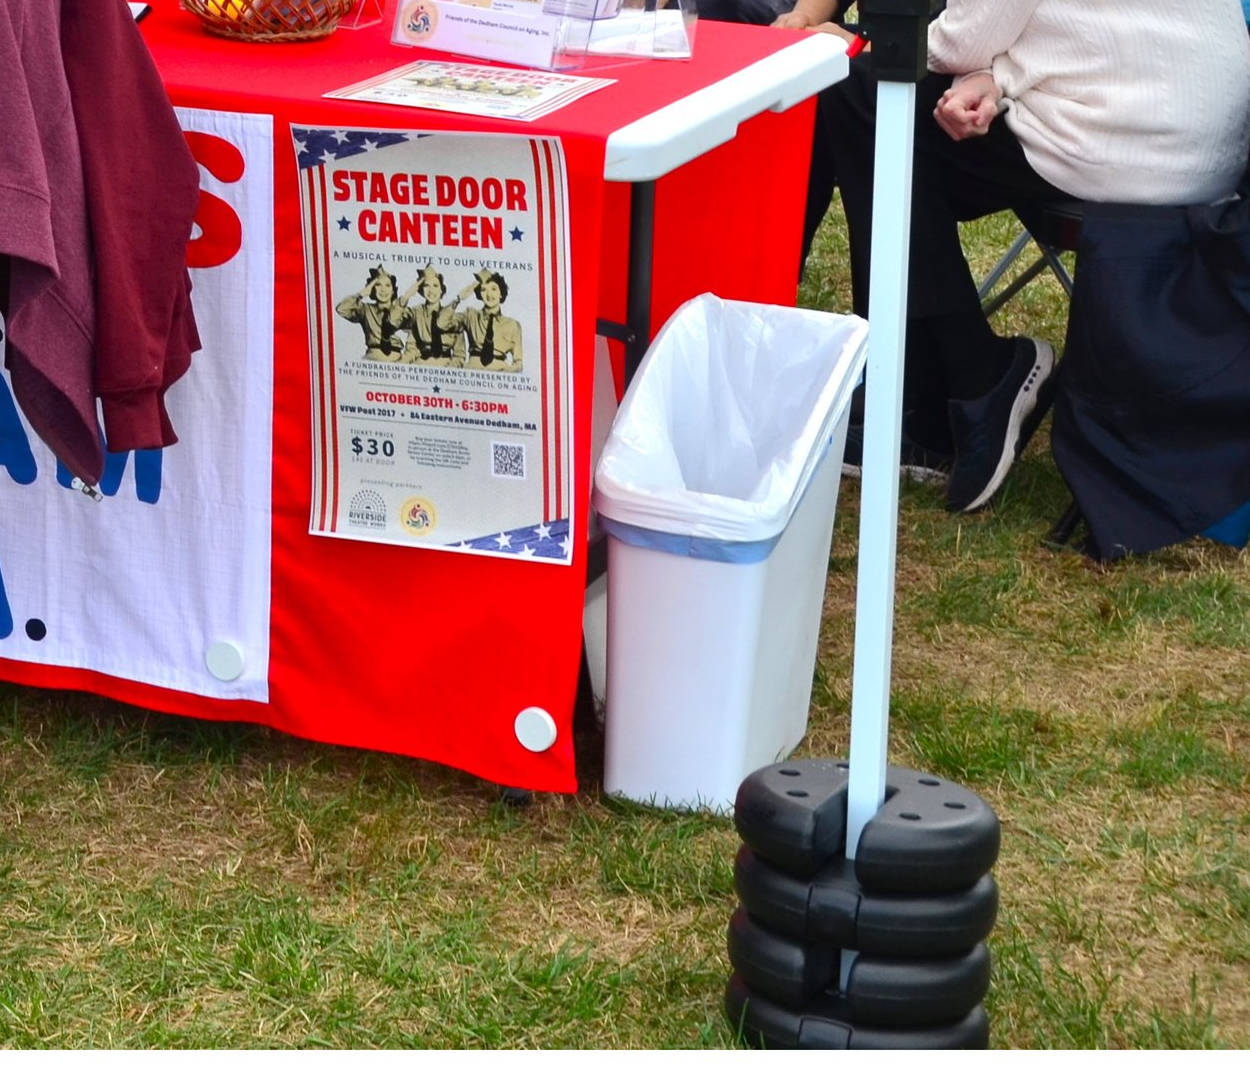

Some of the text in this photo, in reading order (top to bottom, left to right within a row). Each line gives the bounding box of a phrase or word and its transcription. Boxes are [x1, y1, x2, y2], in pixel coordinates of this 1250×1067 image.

[445, 14, 463, 23] Friends
[478, 19, 498, 27] Dedham
[500, 23, 518, 31] Council
[333, 170, 527, 212] STAGE DOOR
[358, 209, 503, 250] CANTEEN
[343, 252, 387, 262] MUSICAL
[391, 254, 434, 265] TRIBUTE
[439, 257, 450, 265] TO
[454, 259, 475, 268] OUR
[479, 260, 533, 271] VETERANS
[339, 368, 351, 376] THE
[356, 370, 389, 379] FRIENDS
[405, 374, 420, 382] THE
[423, 376, 456, 385] DEDHAM
[460, 379, 494, 389] COUNCIL
[352, 362, 406, 373] FUNDRAISING
[409, 367, 467, 379] PERFORMANCE
[471, 372, 517, 383] PRESENTED
[366, 391, 508, 414] OCTOBER 30TH 6:30PM
[340, 405, 536, 431] VFW Post 2017 84 Eastern Avenue Dedham, MA
[351, 436, 394, 457] $30
[350, 512, 386, 522] RIVERSIDE
